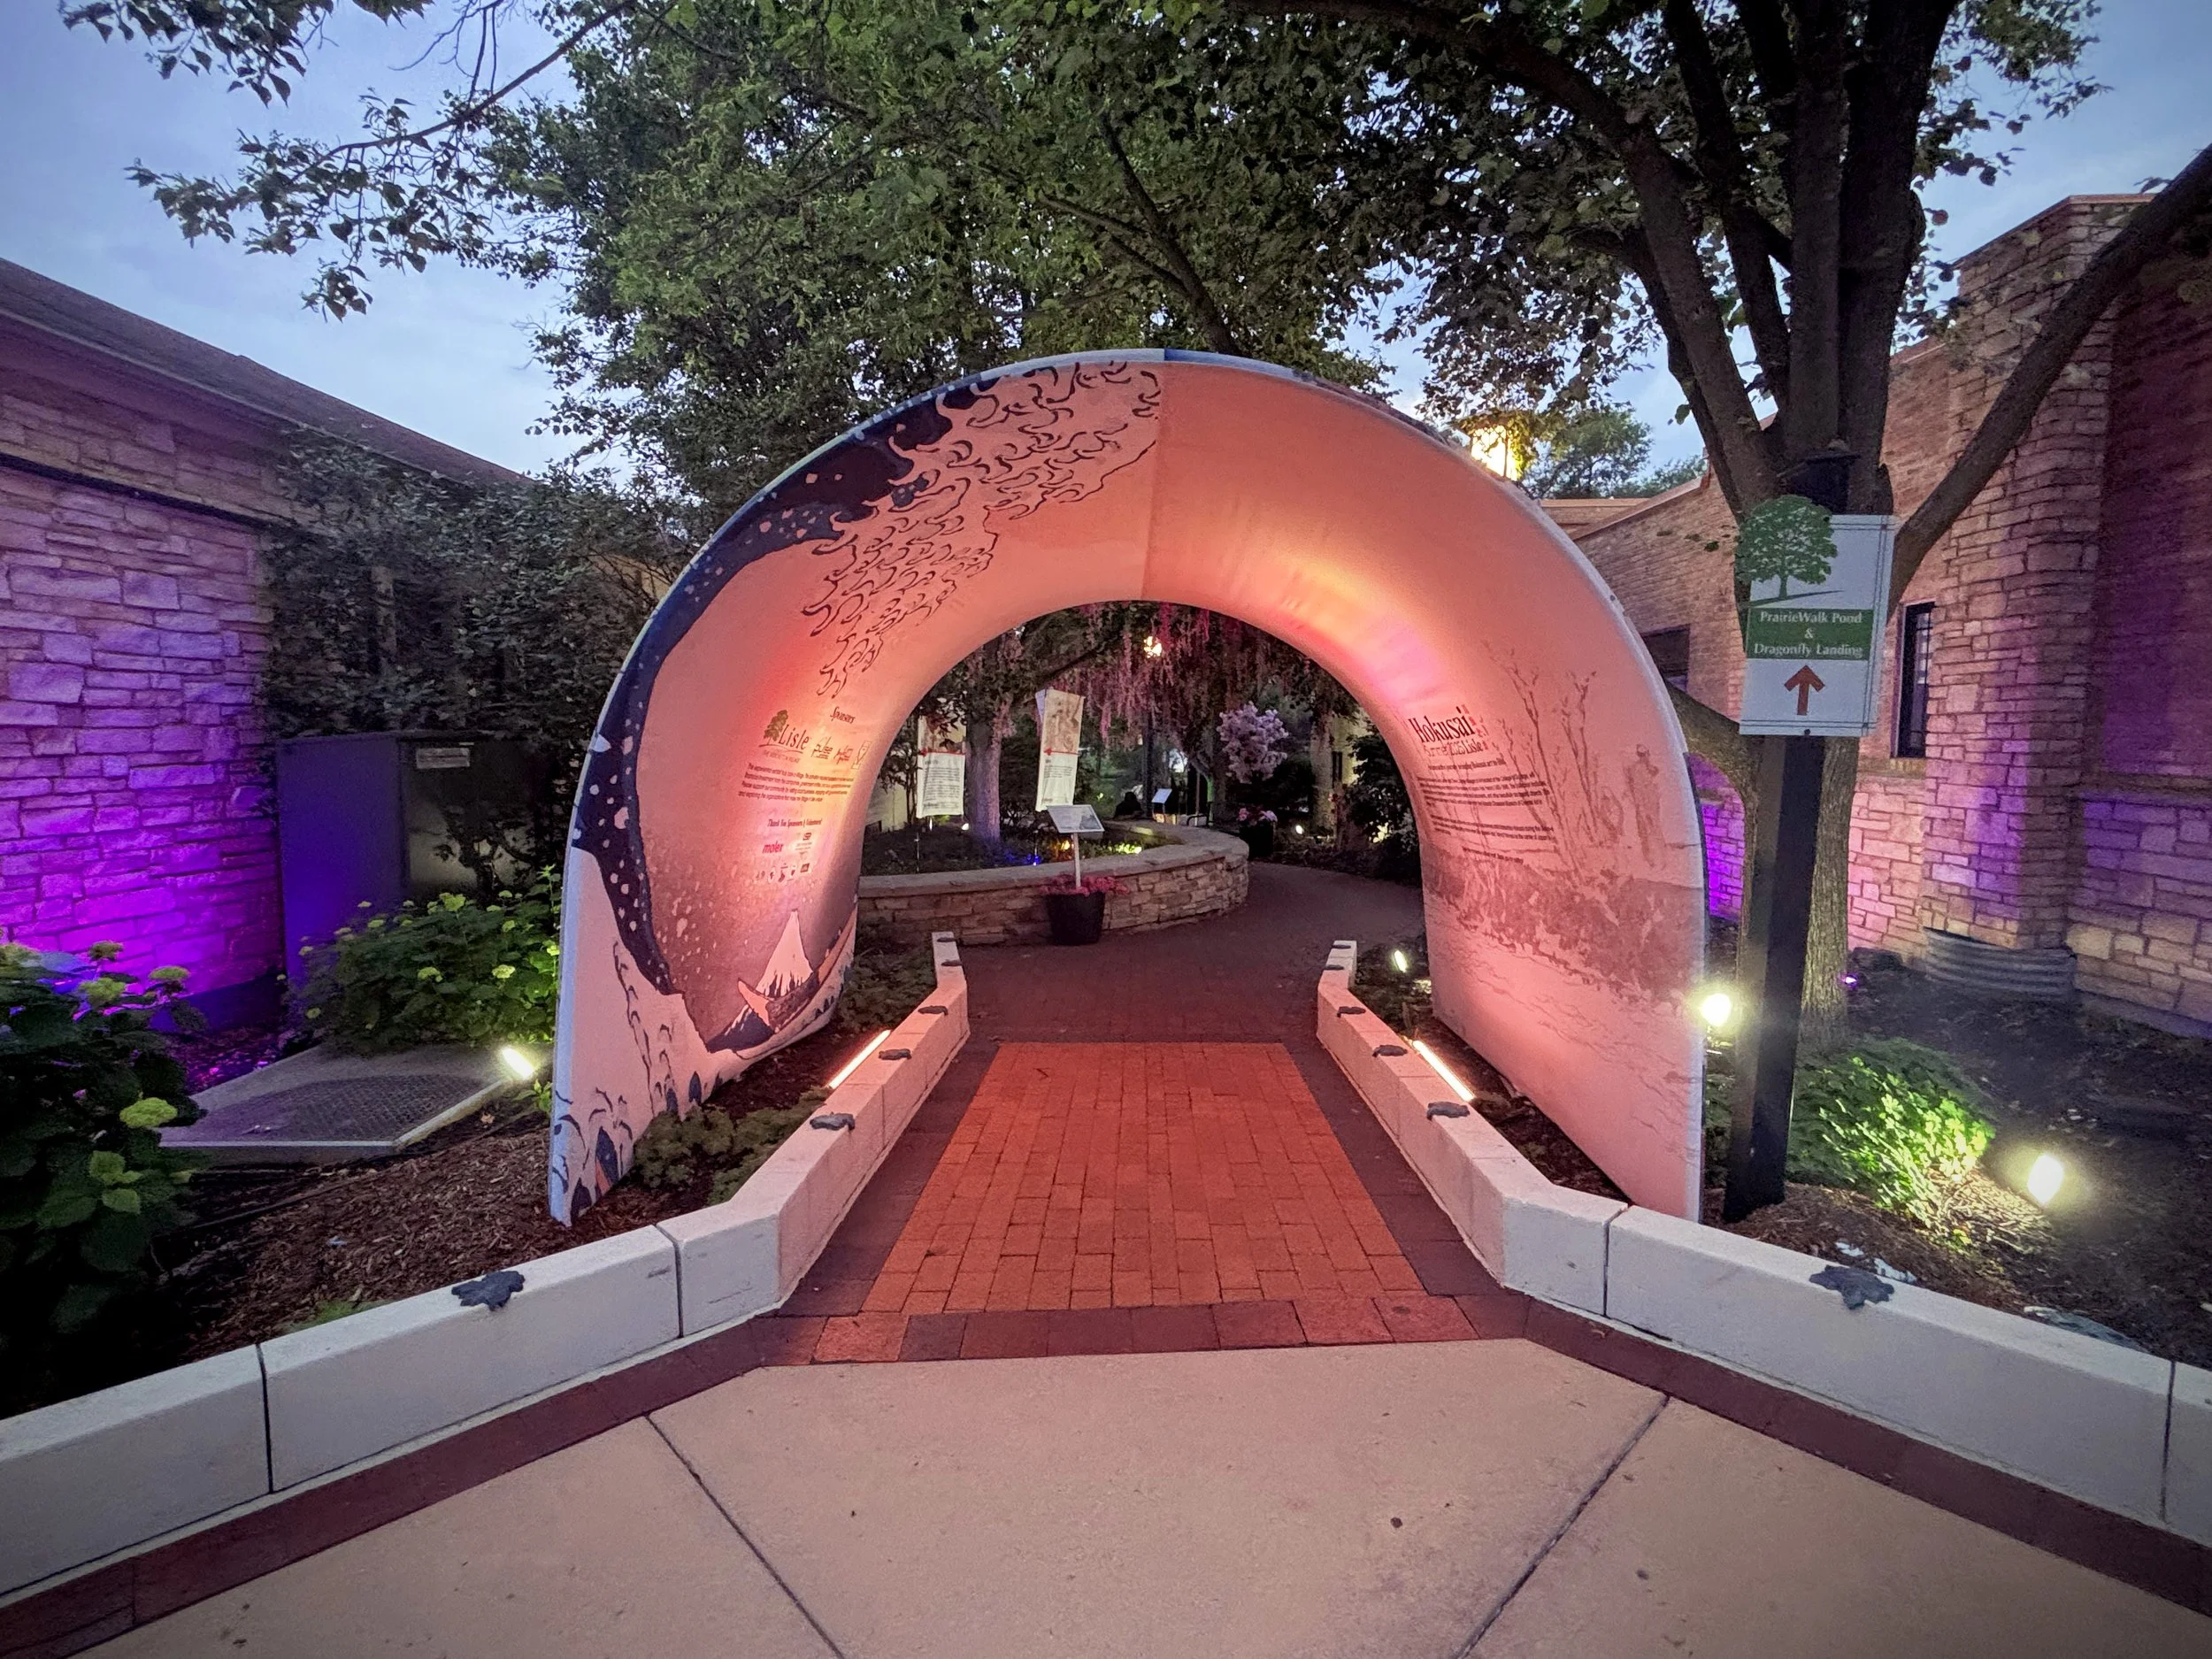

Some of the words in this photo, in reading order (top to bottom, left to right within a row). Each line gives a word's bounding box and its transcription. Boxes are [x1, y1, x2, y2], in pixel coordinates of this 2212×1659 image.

[1760, 611, 1828, 623] PrairieWalk
[1832, 612, 1863, 623] Pond
[1804, 628, 1814, 639] &
[1754, 643, 1811, 657] Dragonfly
[1816, 643, 1863, 657] Landing
[1408, 706, 1476, 743] Hokusai
[778, 724, 810, 750] Lisle
